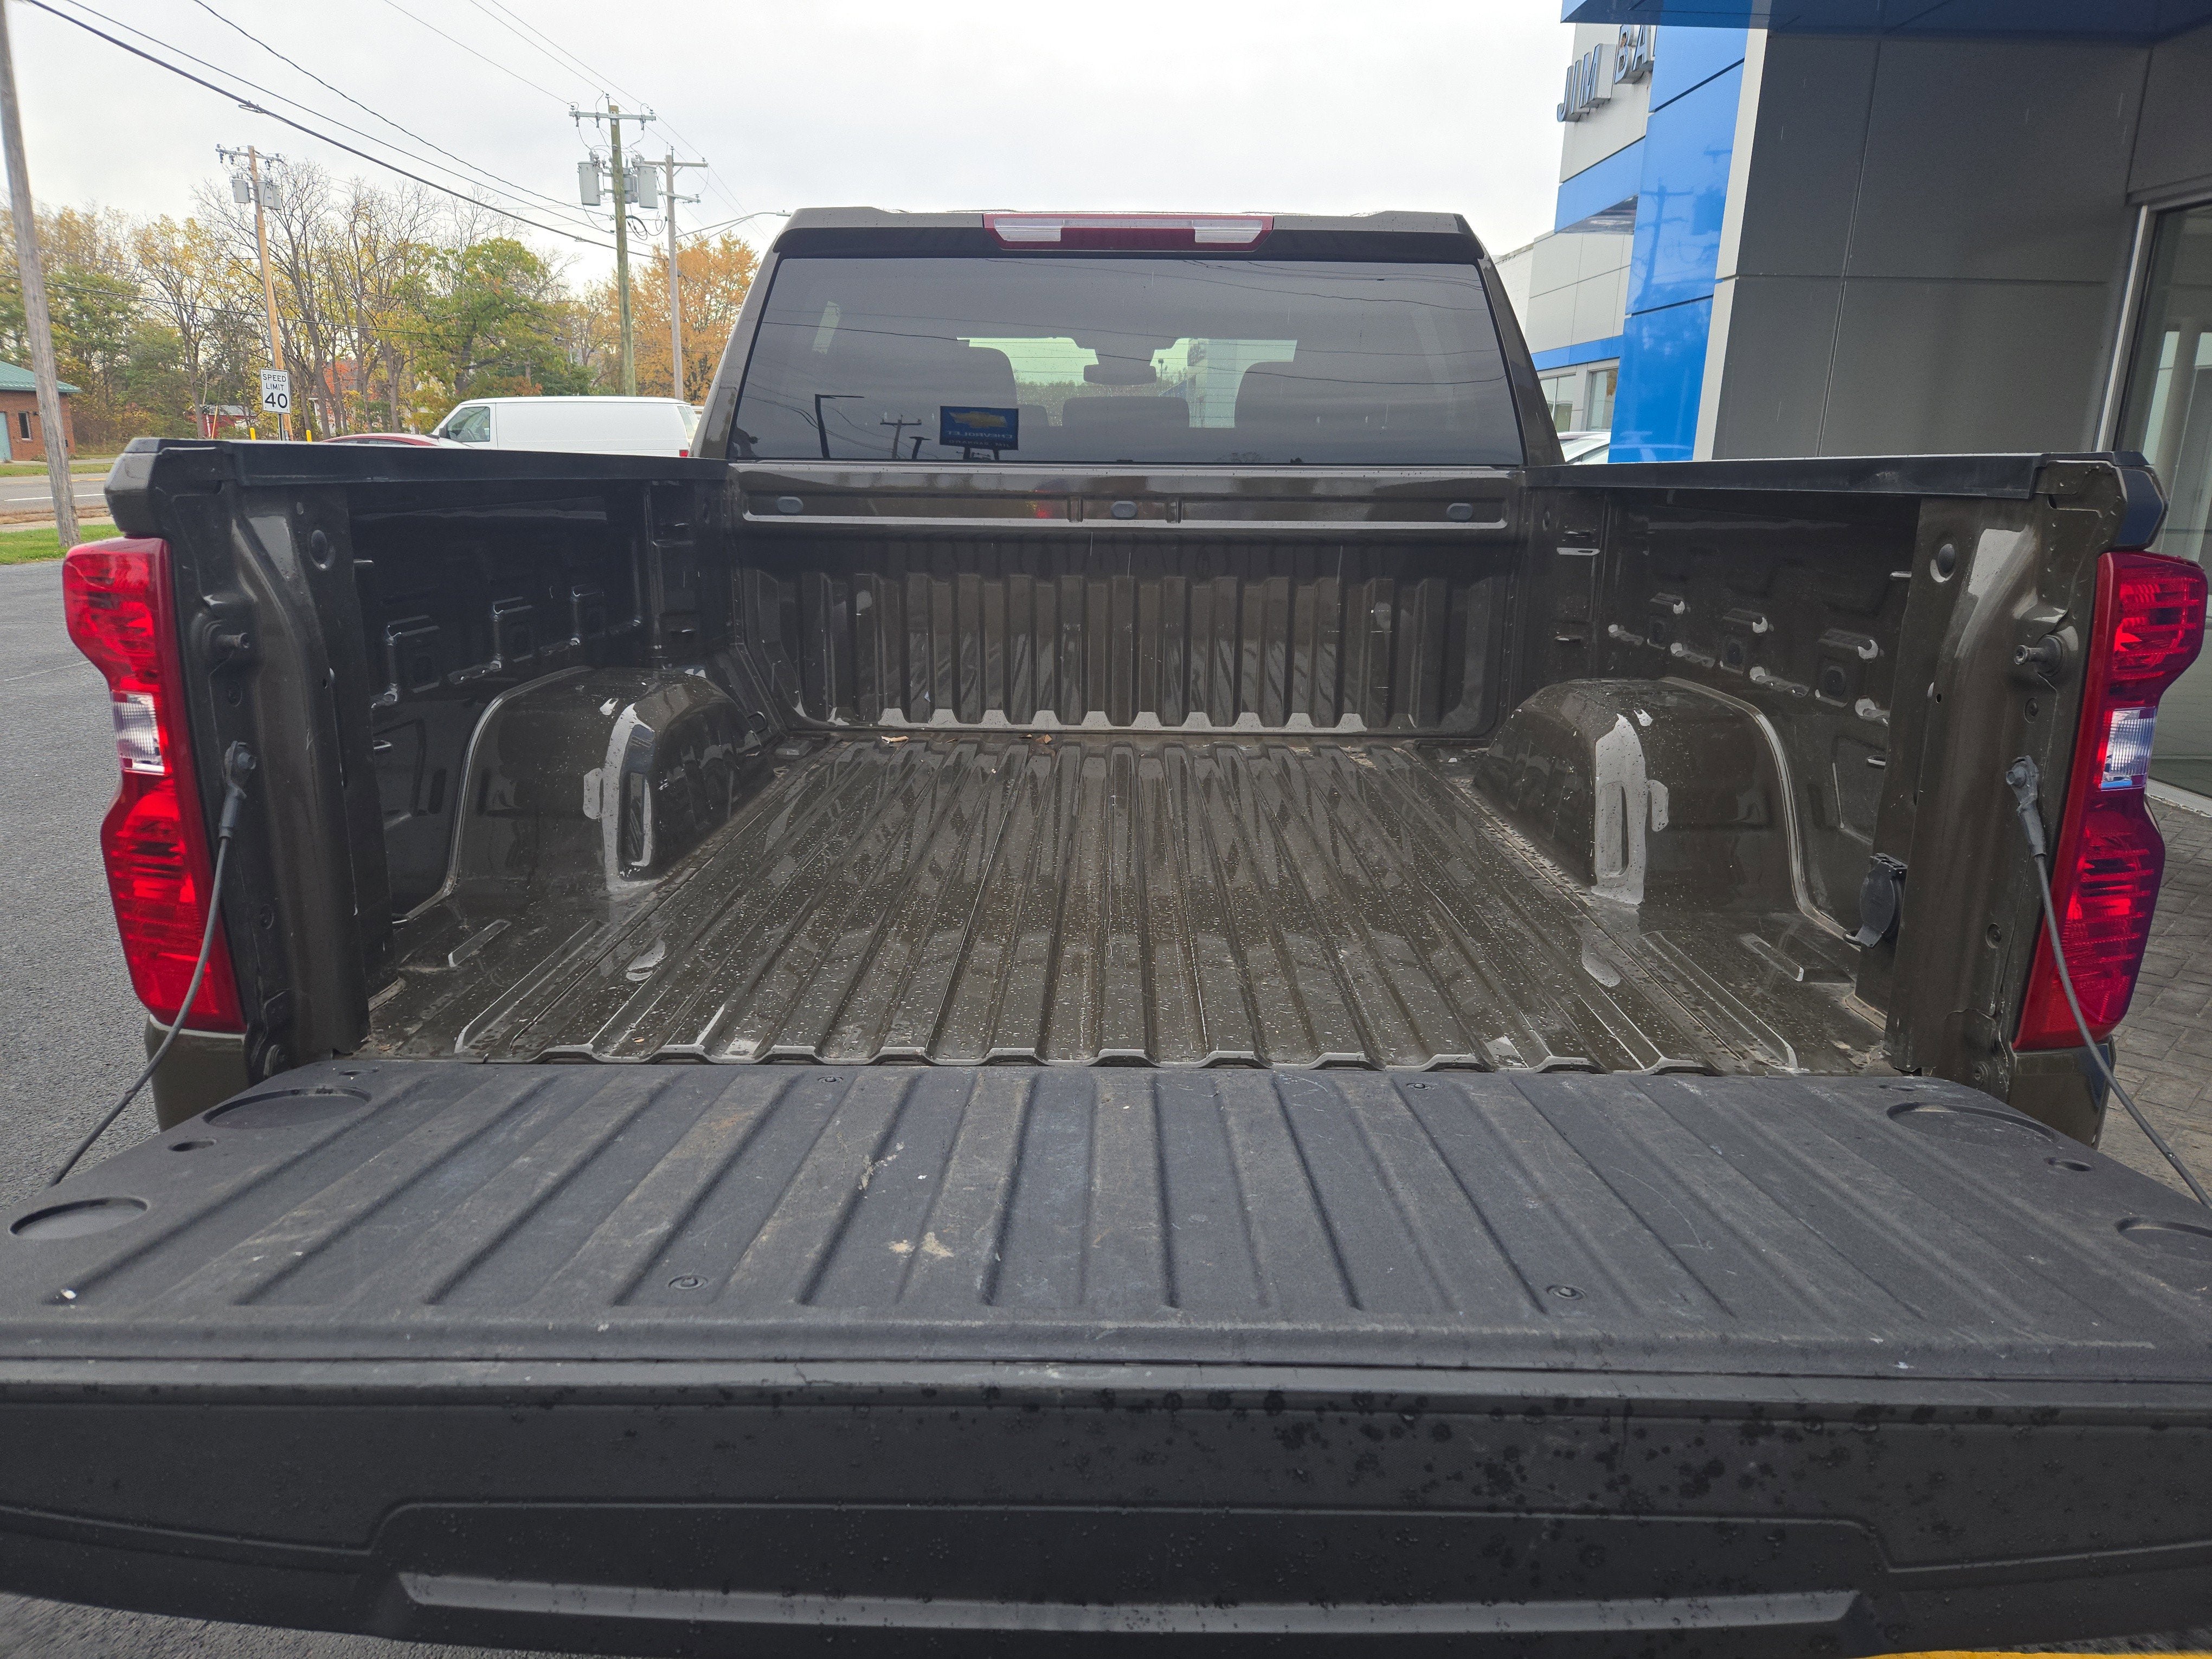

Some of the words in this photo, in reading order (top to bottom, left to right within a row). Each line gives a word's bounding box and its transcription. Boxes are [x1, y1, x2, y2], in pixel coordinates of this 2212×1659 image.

[1557, 43, 1608, 122] JIM
[1614, 24, 1657, 85] BA
[262, 374, 287, 382] SPEED
[266, 382, 285, 391] LIMIT
[264, 392, 288, 409] 40
